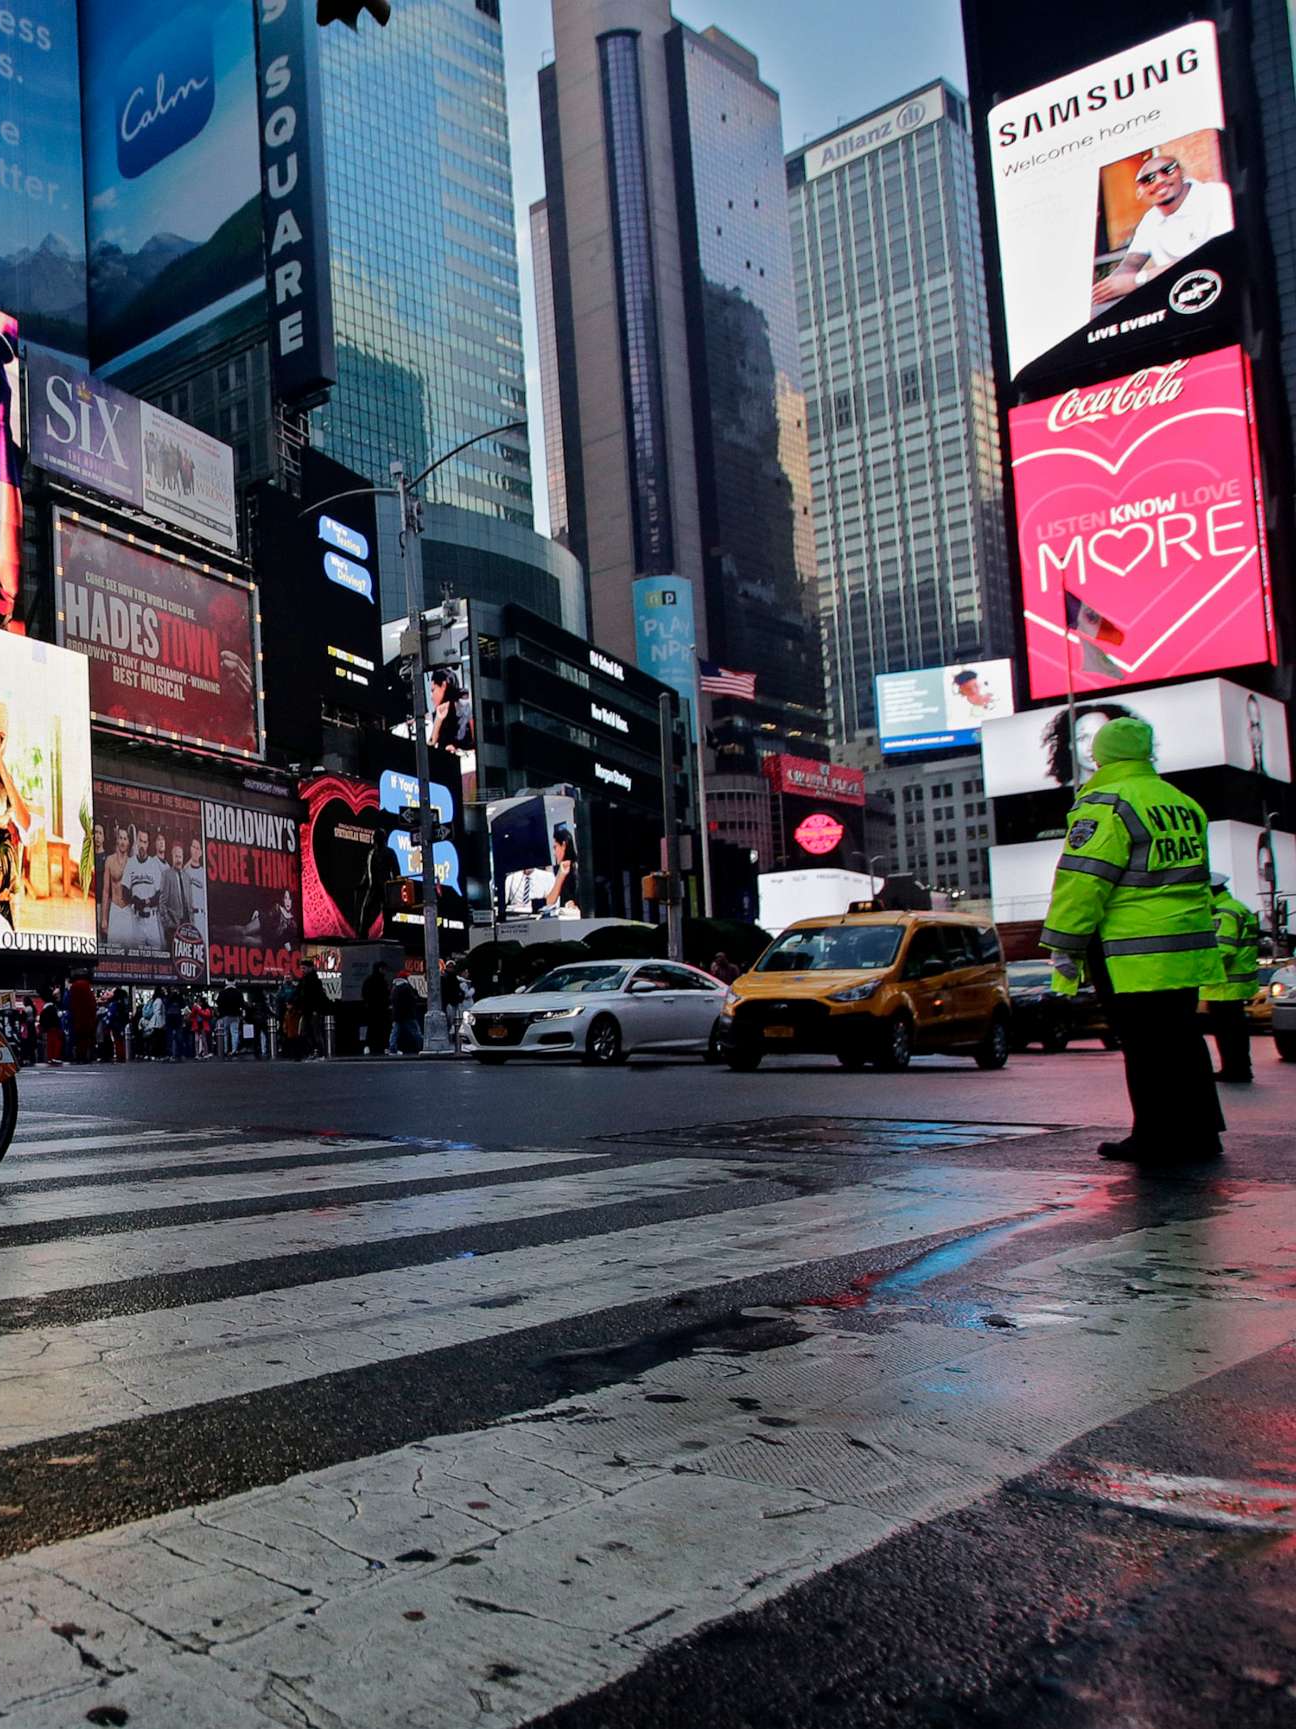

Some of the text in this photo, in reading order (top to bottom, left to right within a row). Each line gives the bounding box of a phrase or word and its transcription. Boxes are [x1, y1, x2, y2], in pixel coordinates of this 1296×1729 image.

[121, 73, 208, 142] Calm
[998, 48, 1199, 147] SAMSUNG
[821, 121, 892, 168] Allianz
[1003, 107, 1161, 177] Welcome home
[265, 55, 304, 356] SQUARE
[1087, 309, 1167, 343] LIVE EVENT
[1036, 479, 1240, 541] LISTEN KNOW LOVE
[134, 588, 146, 603] THE
[66, 638, 117, 665] BROADWAY'S
[117, 652, 139, 671] TONY
[140, 660, 155, 675] AND
[112, 666, 185, 701] BEST MUSICAL
[391, 775, 397, 788] If
[205, 801, 296, 853] BROADWAY'S
[207, 842, 249, 886] SURE
[2, 930, 97, 955] OUTFITTERS
[174, 938, 204, 963] TAKE ME
[180, 962, 197, 977] OUT
